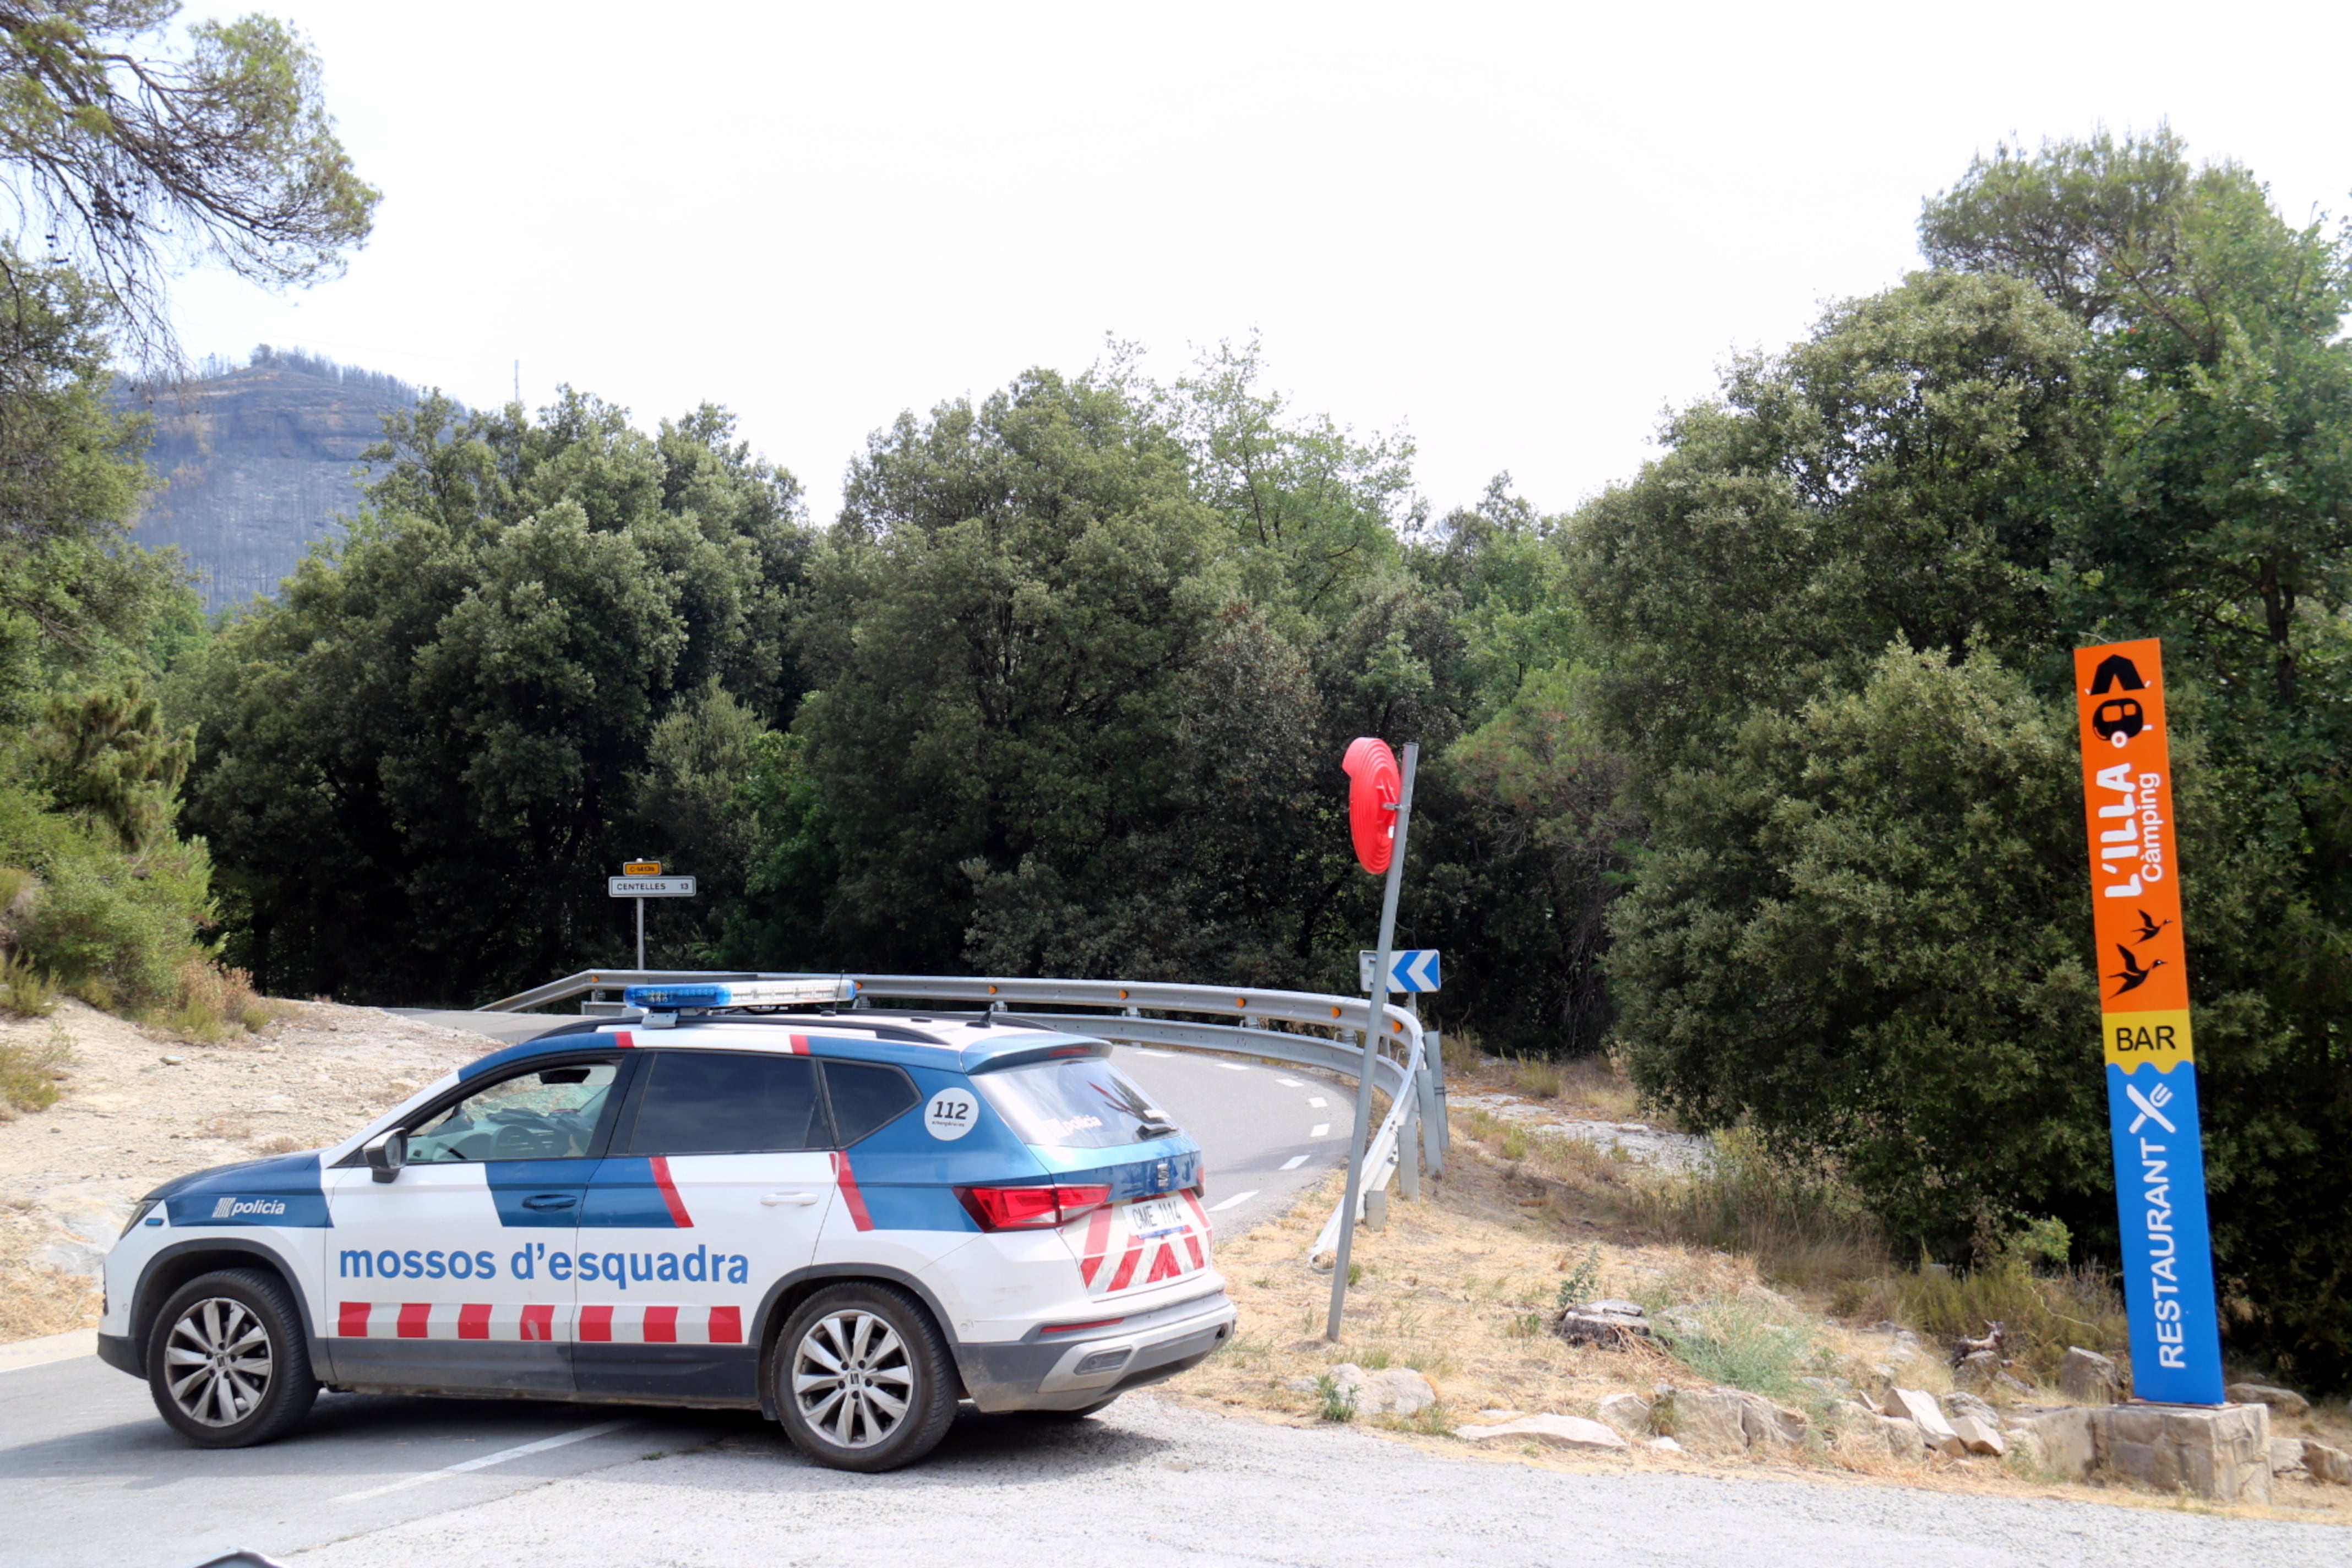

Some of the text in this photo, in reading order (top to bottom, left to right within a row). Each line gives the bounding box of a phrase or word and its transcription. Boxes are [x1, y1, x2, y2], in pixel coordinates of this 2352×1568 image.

[2096, 763, 2143, 898] L'ILLA
[2136, 772, 2164, 883] Càmping
[2116, 1025, 2176, 1052] BAR
[934, 1101, 969, 1120] 112
[1061, 1114, 1103, 1134] policia
[231, 1199, 286, 1216] policia
[1132, 1205, 1157, 1229] CME
[2139, 1136, 2187, 1369] RESTAURANT
[339, 1243, 749, 1290] mossos d'esquadra
